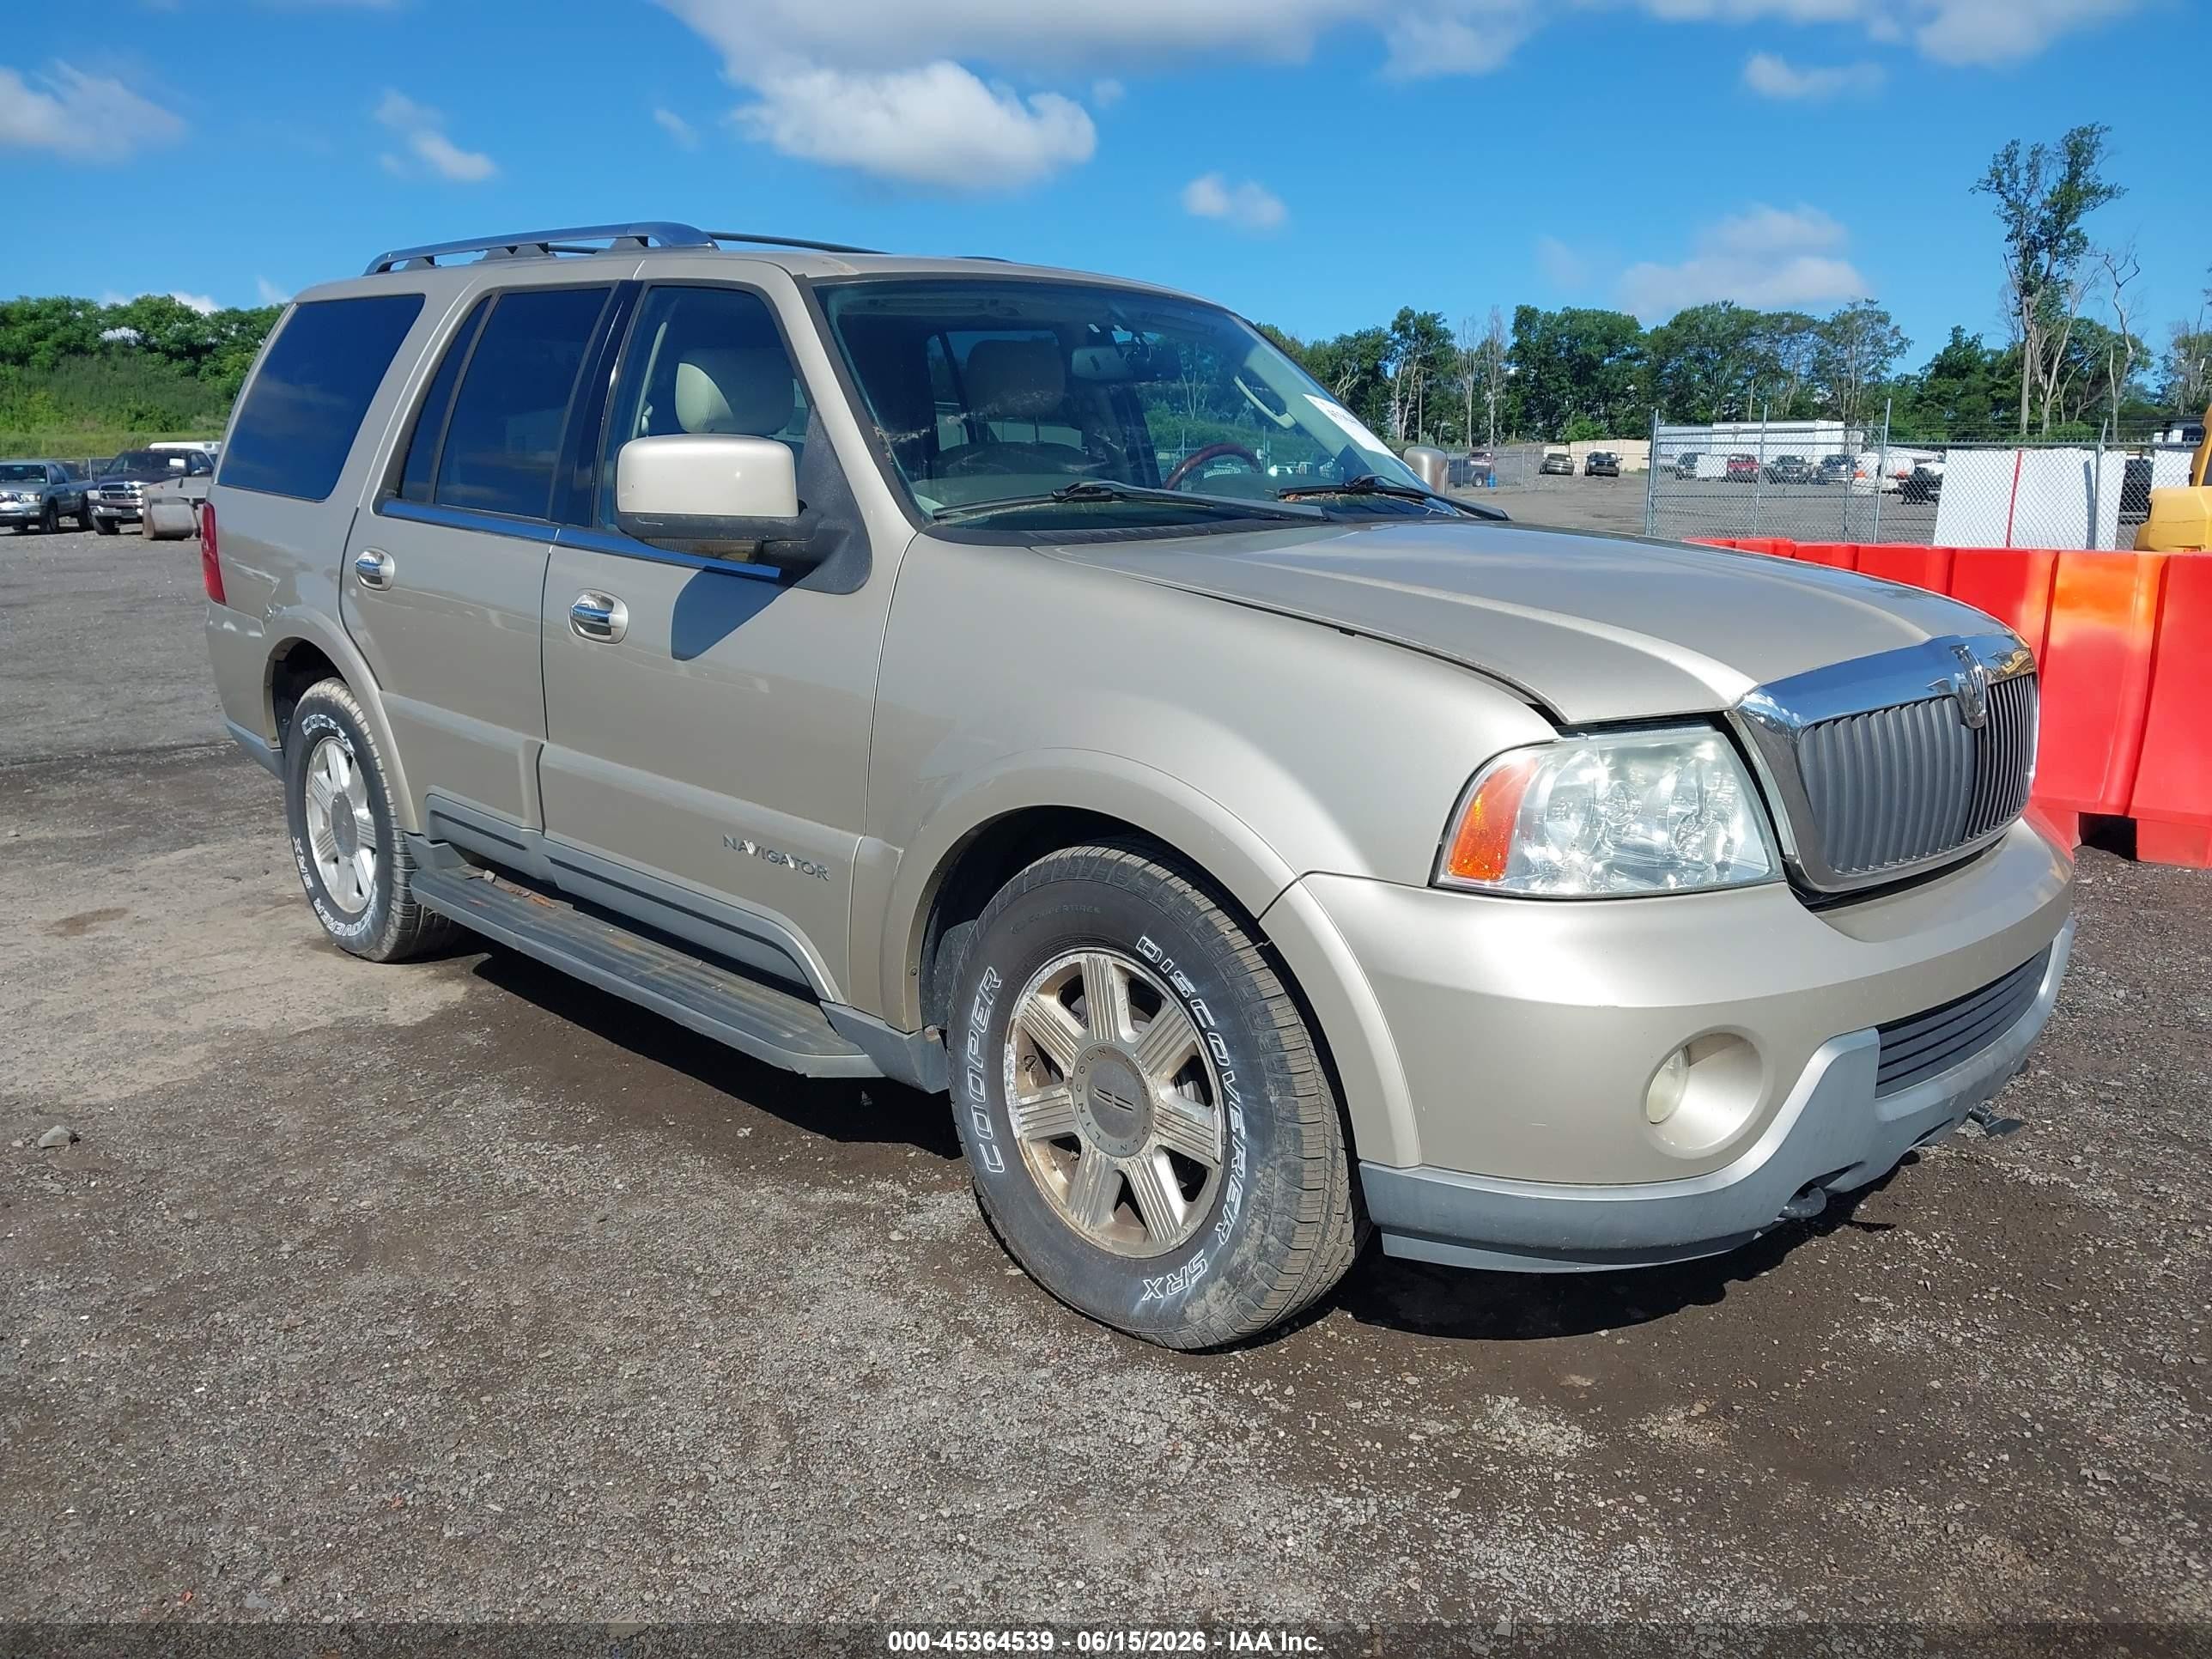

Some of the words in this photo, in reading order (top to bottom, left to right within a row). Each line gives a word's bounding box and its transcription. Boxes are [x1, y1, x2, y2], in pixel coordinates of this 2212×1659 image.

[722, 833, 830, 881] NAVIGATOR
[313, 880, 379, 937] COVERER
[967, 966, 1003, 1173] COOPER
[1075, 1048, 1107, 1140] LINCOLN
[1135, 935, 1247, 1246] DISCOVERER
[1141, 1249, 1209, 1302] SRX
